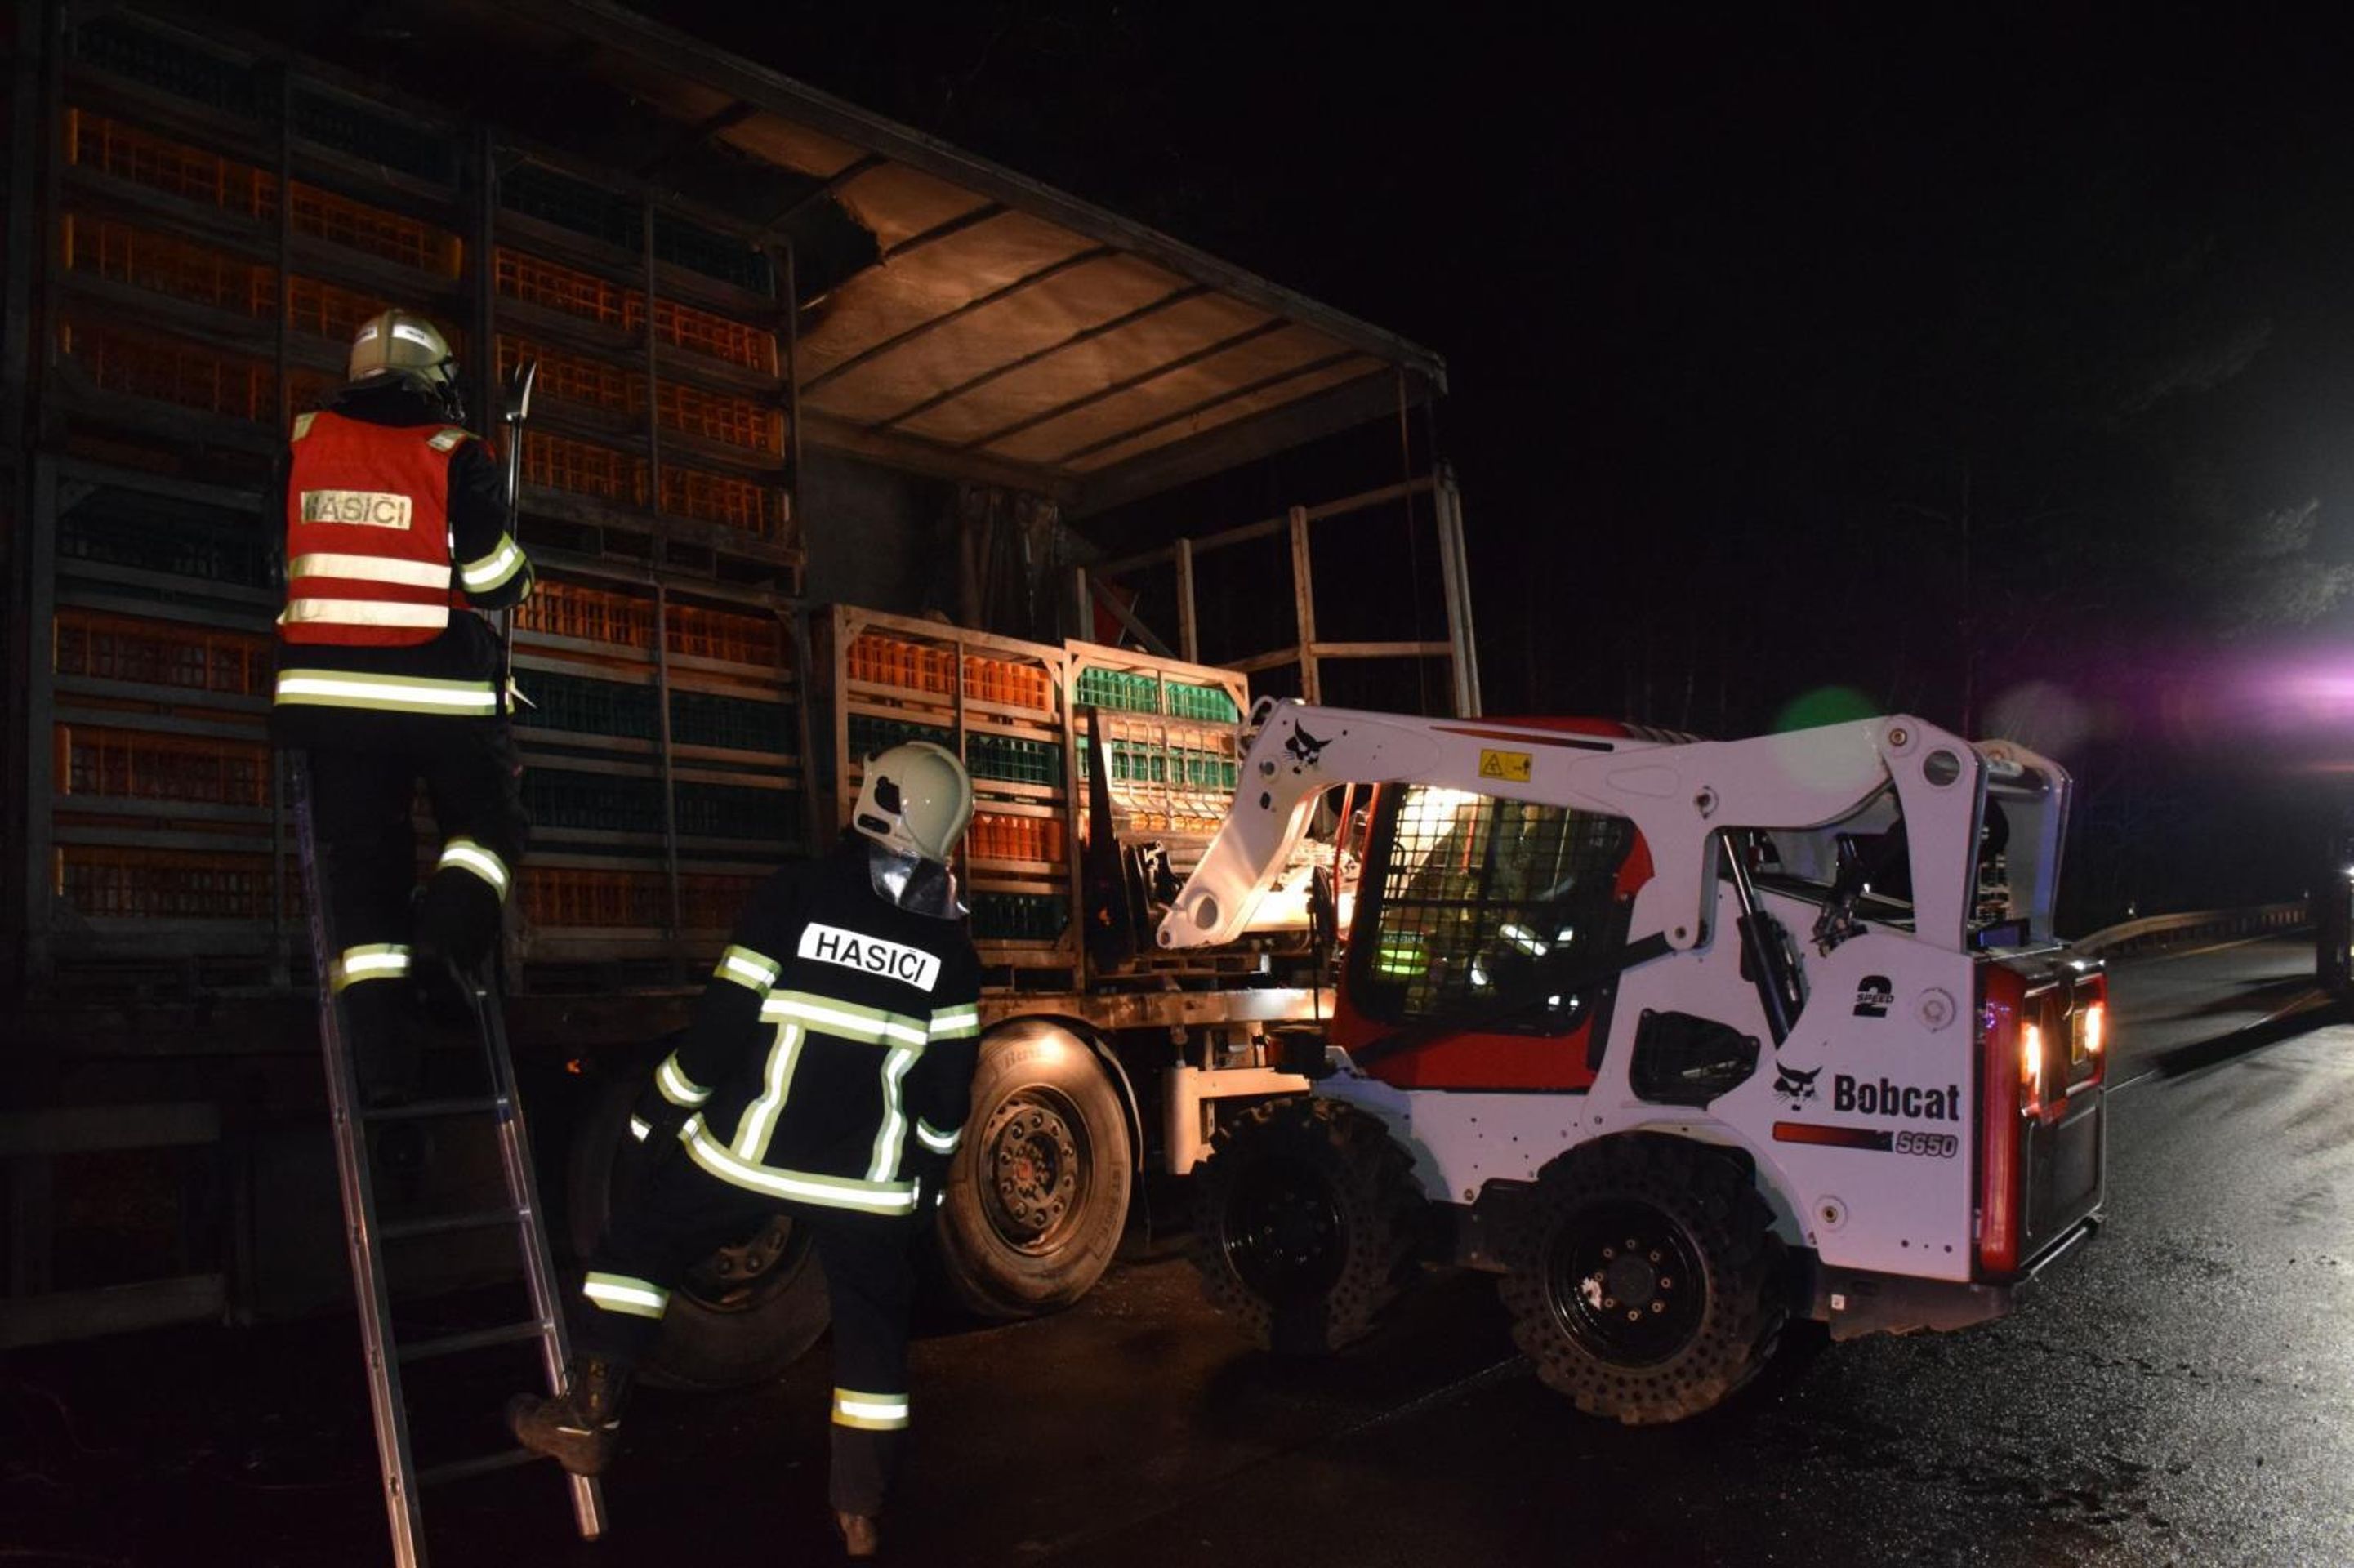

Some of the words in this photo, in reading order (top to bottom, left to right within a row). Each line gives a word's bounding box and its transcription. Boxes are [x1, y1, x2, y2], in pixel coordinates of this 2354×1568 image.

[1852, 974, 1893, 1018] 2
[1856, 993, 1895, 1004] SPEED
[1834, 1073, 1959, 1121] Bobcat
[1895, 1130, 1958, 1158] S650
